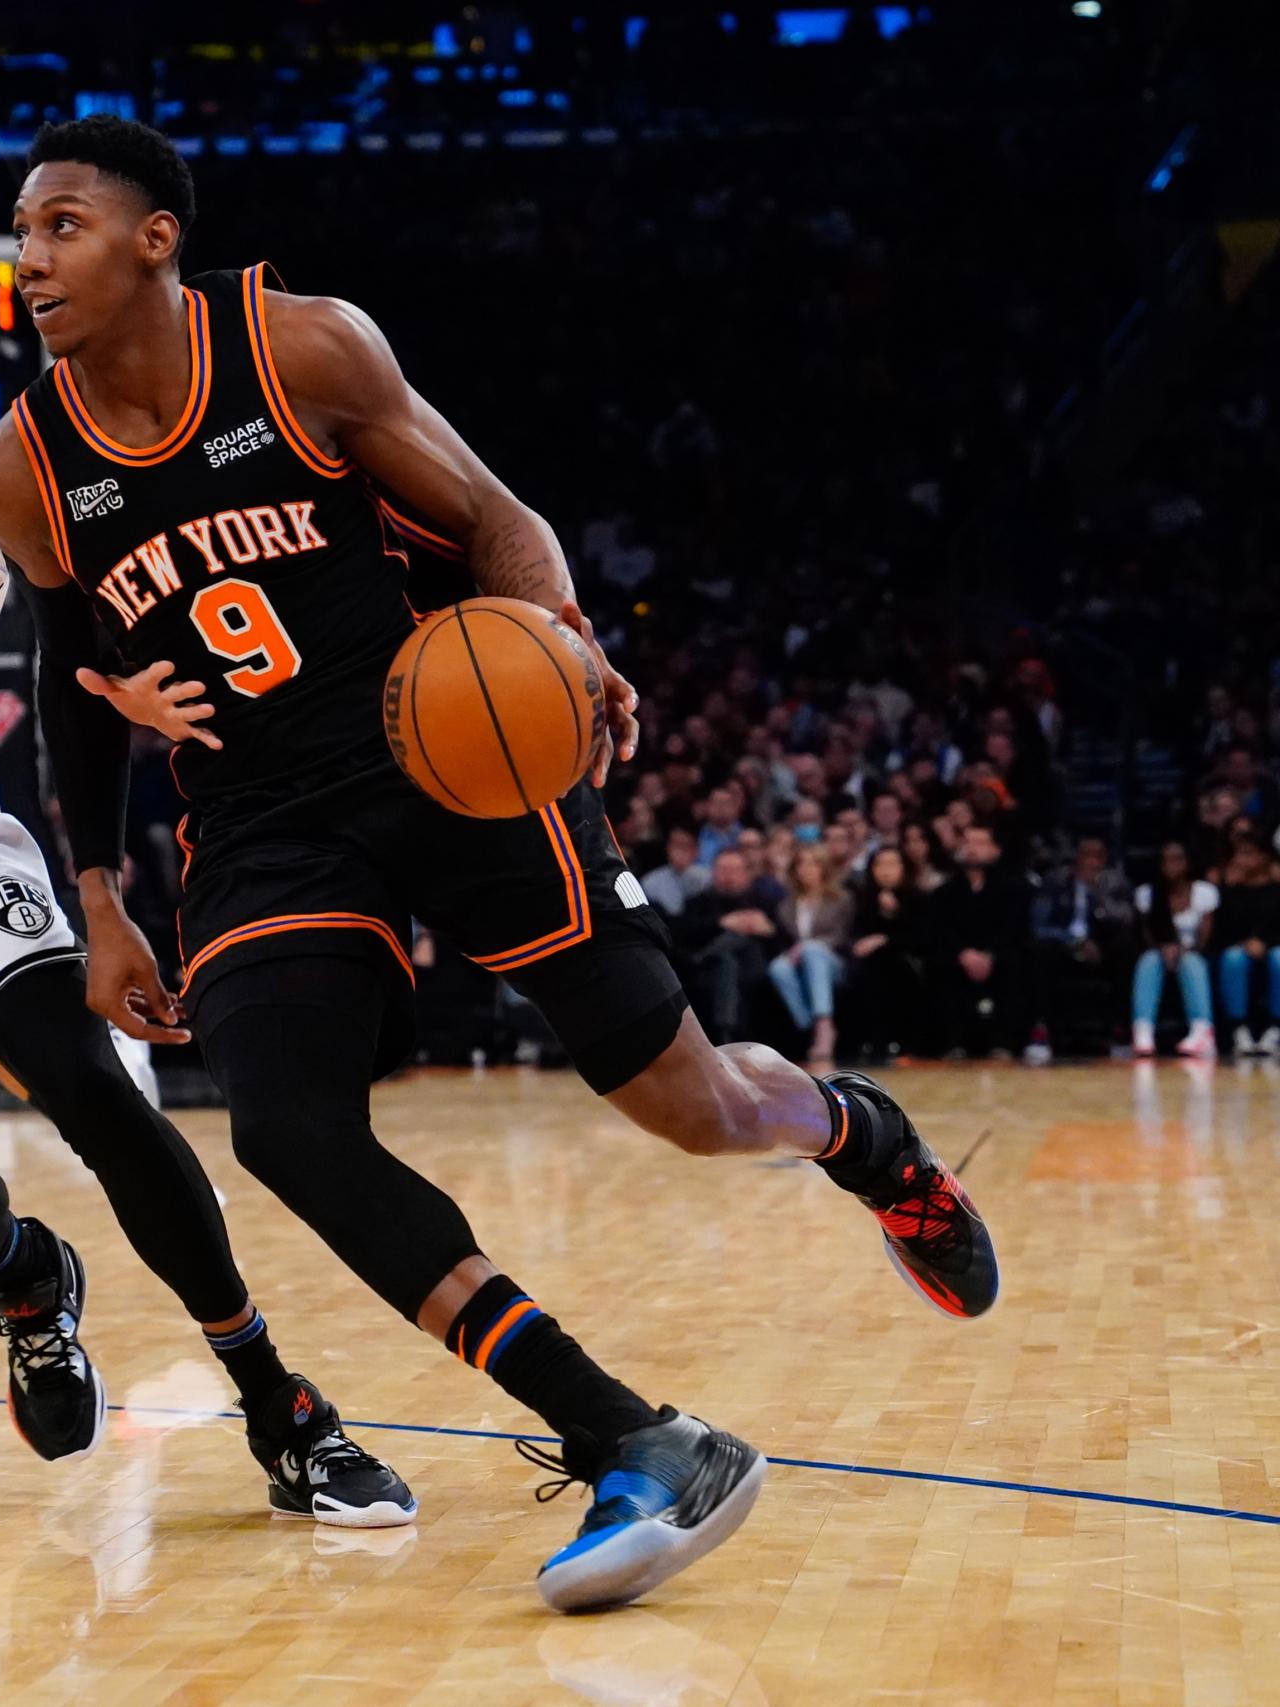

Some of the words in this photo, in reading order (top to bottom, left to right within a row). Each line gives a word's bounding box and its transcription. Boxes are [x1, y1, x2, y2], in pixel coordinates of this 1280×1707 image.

[203, 417, 268, 455] SQUARE
[209, 436, 262, 468] SPACE
[96, 532, 183, 631] NEW
[177, 500, 328, 575] YORK
[188, 577, 302, 699] 9
[19, 905, 36, 928] B
